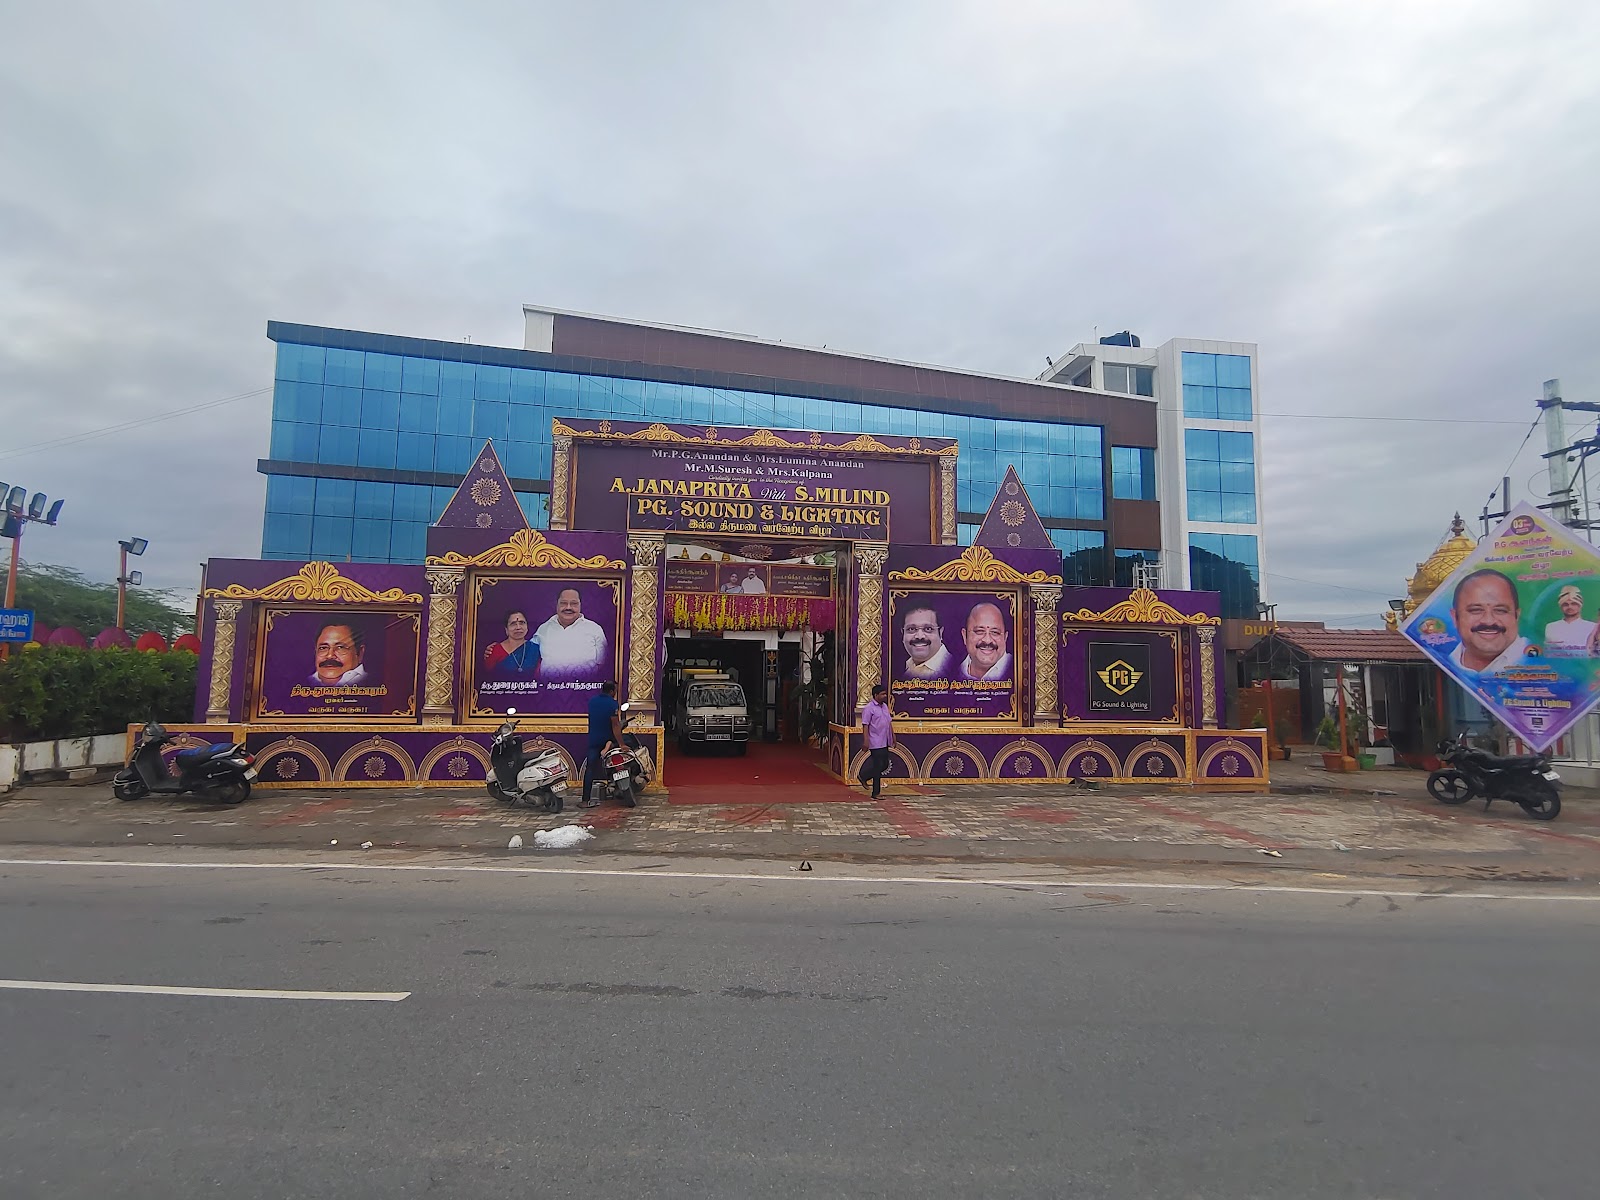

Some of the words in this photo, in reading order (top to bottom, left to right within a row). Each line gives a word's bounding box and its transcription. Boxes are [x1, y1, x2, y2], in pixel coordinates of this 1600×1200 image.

[651, 449, 740, 463] Mr.P.G.Anandan
[743, 453, 752, 462] &
[755, 454, 817, 466] Mrs.Lumina
[820, 458, 864, 468] Anandan
[684, 463, 752, 475] Mr.M.Suresh
[755, 466, 765, 475] &
[767, 467, 833, 479] Mrs.Kalpana
[609, 477, 752, 498] A.JANAPRIYA
[760, 487, 787, 500] With
[794, 486, 891, 505] S.MILIND
[637, 498, 673, 516] PG.
[680, 501, 754, 519] SOUND
[760, 504, 775, 520] &
[780, 505, 881, 526] LIGHTING
[688, 518, 715, 531] இல்ல
[719, 519, 757, 532] திருமண
[762, 522, 804, 536] வரவேற்பு
[808, 524, 833, 537] விழா
[1112, 669, 1129, 685] PG
[1092, 700, 1101, 708] PG
[1126, 701, 1148, 709] Lighting
